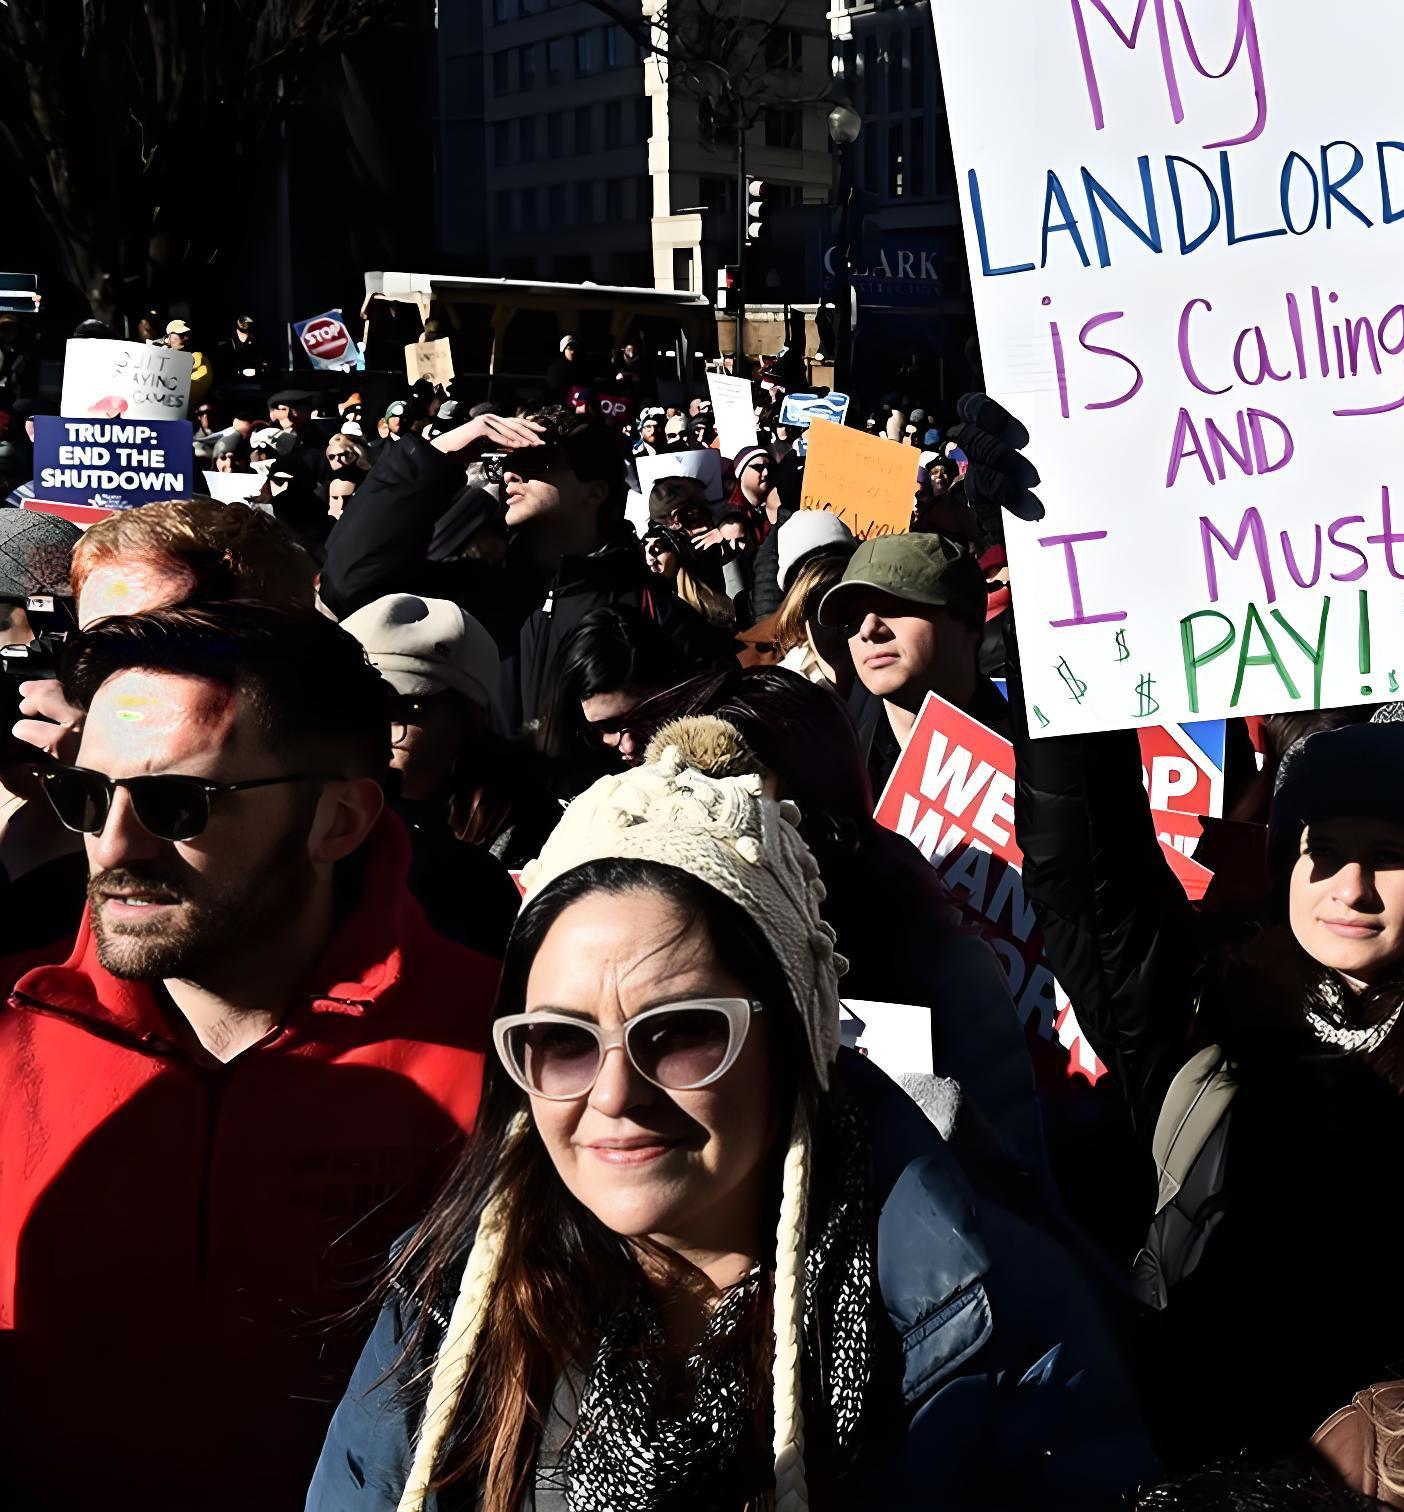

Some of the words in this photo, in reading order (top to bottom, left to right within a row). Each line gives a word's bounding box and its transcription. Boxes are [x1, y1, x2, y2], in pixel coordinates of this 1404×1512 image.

[304, 323, 340, 346] STOP
[58, 445, 111, 466] END
[115, 448, 165, 468] THE
[64, 423, 158, 445] TRUMP:
[1165, 407, 1294, 487] AND
[40, 467, 184, 492] SHUTDOWN
[1038, 531, 1128, 627] I
[1180, 590, 1373, 713] PAY!
[919, 730, 1016, 847] WE
[896, 792, 1038, 944] WAN
